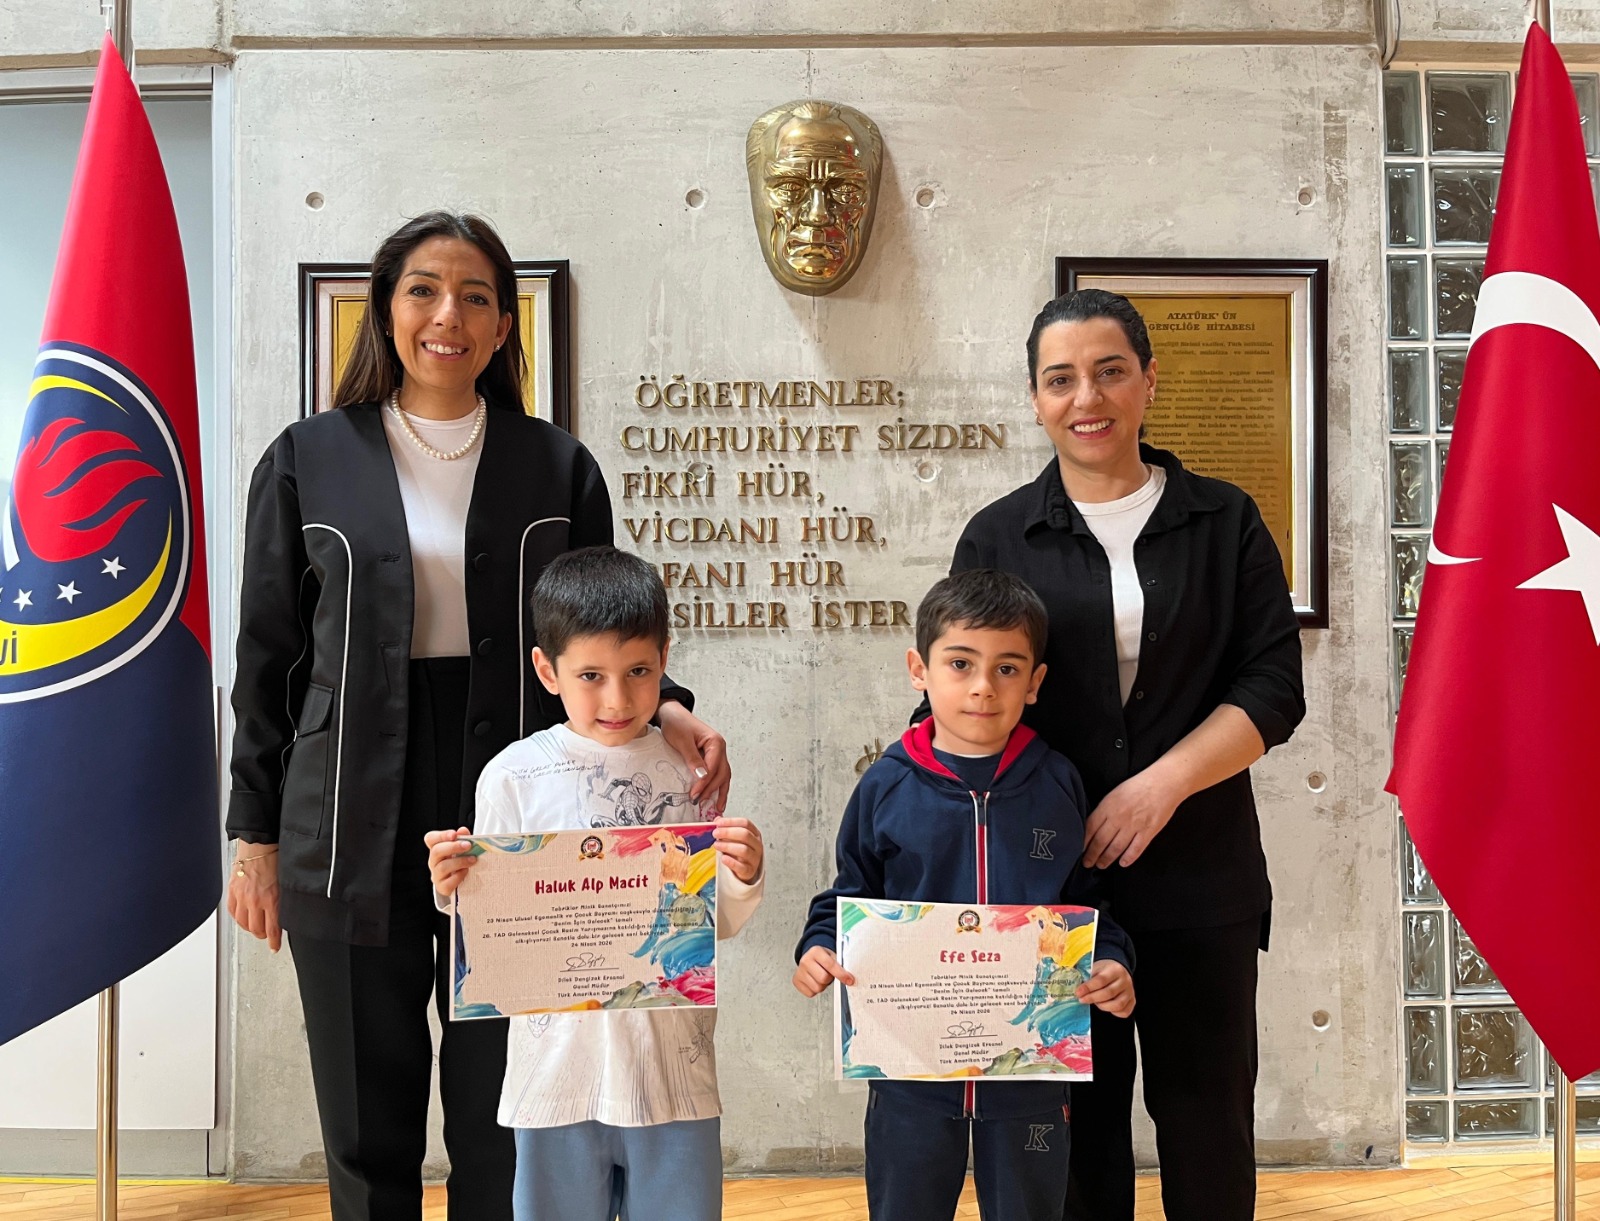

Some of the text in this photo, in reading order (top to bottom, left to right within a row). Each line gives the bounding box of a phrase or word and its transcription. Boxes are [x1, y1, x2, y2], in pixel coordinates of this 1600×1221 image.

[1148, 322, 1256, 332] GENÇLİĞE HİTABESİ
[634, 374, 904, 409] ÖĞRETMENLER;
[620, 417, 1005, 452] CUMHURİYET SİZDEN
[622, 462, 824, 503] FİKRİ HÜR,
[622, 506, 886, 548] VİCDANI HÜR,
[770, 553, 846, 587] HÜR
[669, 596, 911, 628] SİLLER İSTER
[1030, 828, 1057, 860] K
[535, 874, 649, 895] Haluk Alp Macit
[940, 950, 1001, 963] Efe Seza
[1024, 1124, 1054, 1152] K
